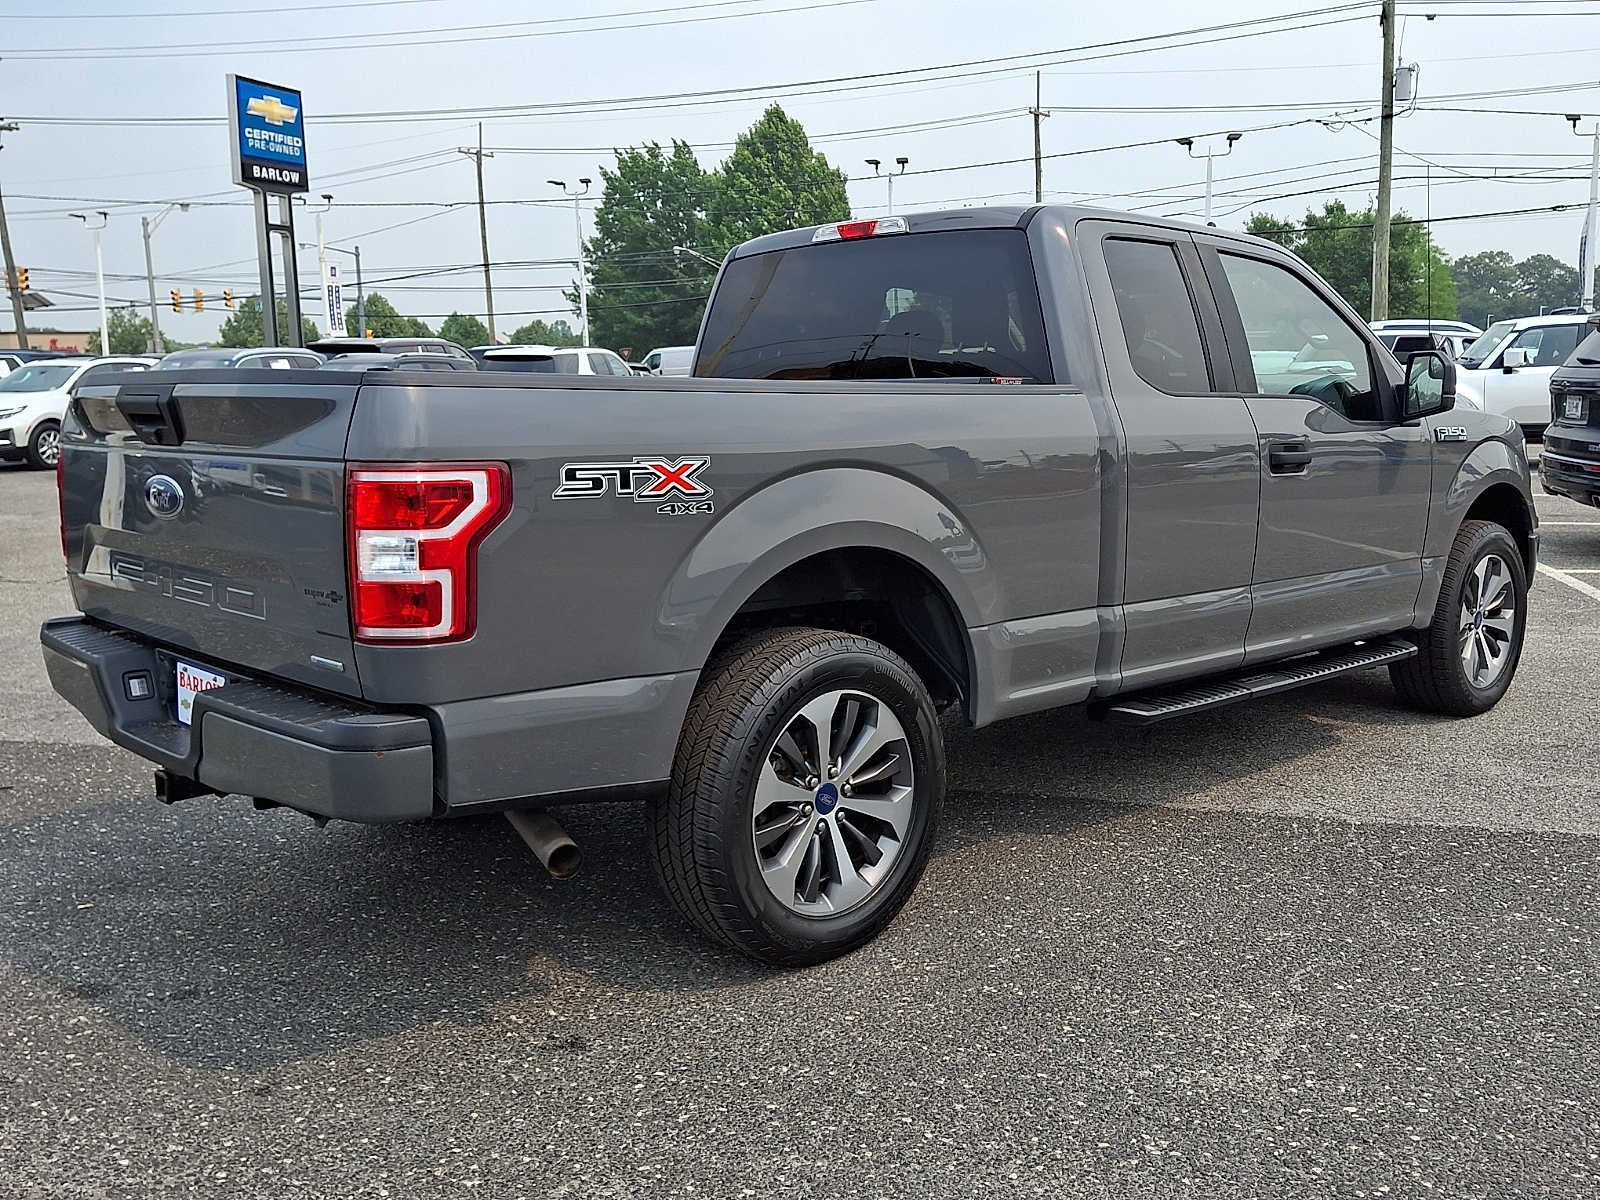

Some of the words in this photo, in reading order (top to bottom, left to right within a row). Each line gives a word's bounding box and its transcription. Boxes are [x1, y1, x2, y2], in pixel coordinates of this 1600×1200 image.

[245, 127, 302, 147] CERTIFIED
[248, 138, 301, 156] PRE-OWNED
[252, 165, 300, 183] BARLOW
[552, 456, 714, 502] STX
[109, 549, 267, 621] F-150
